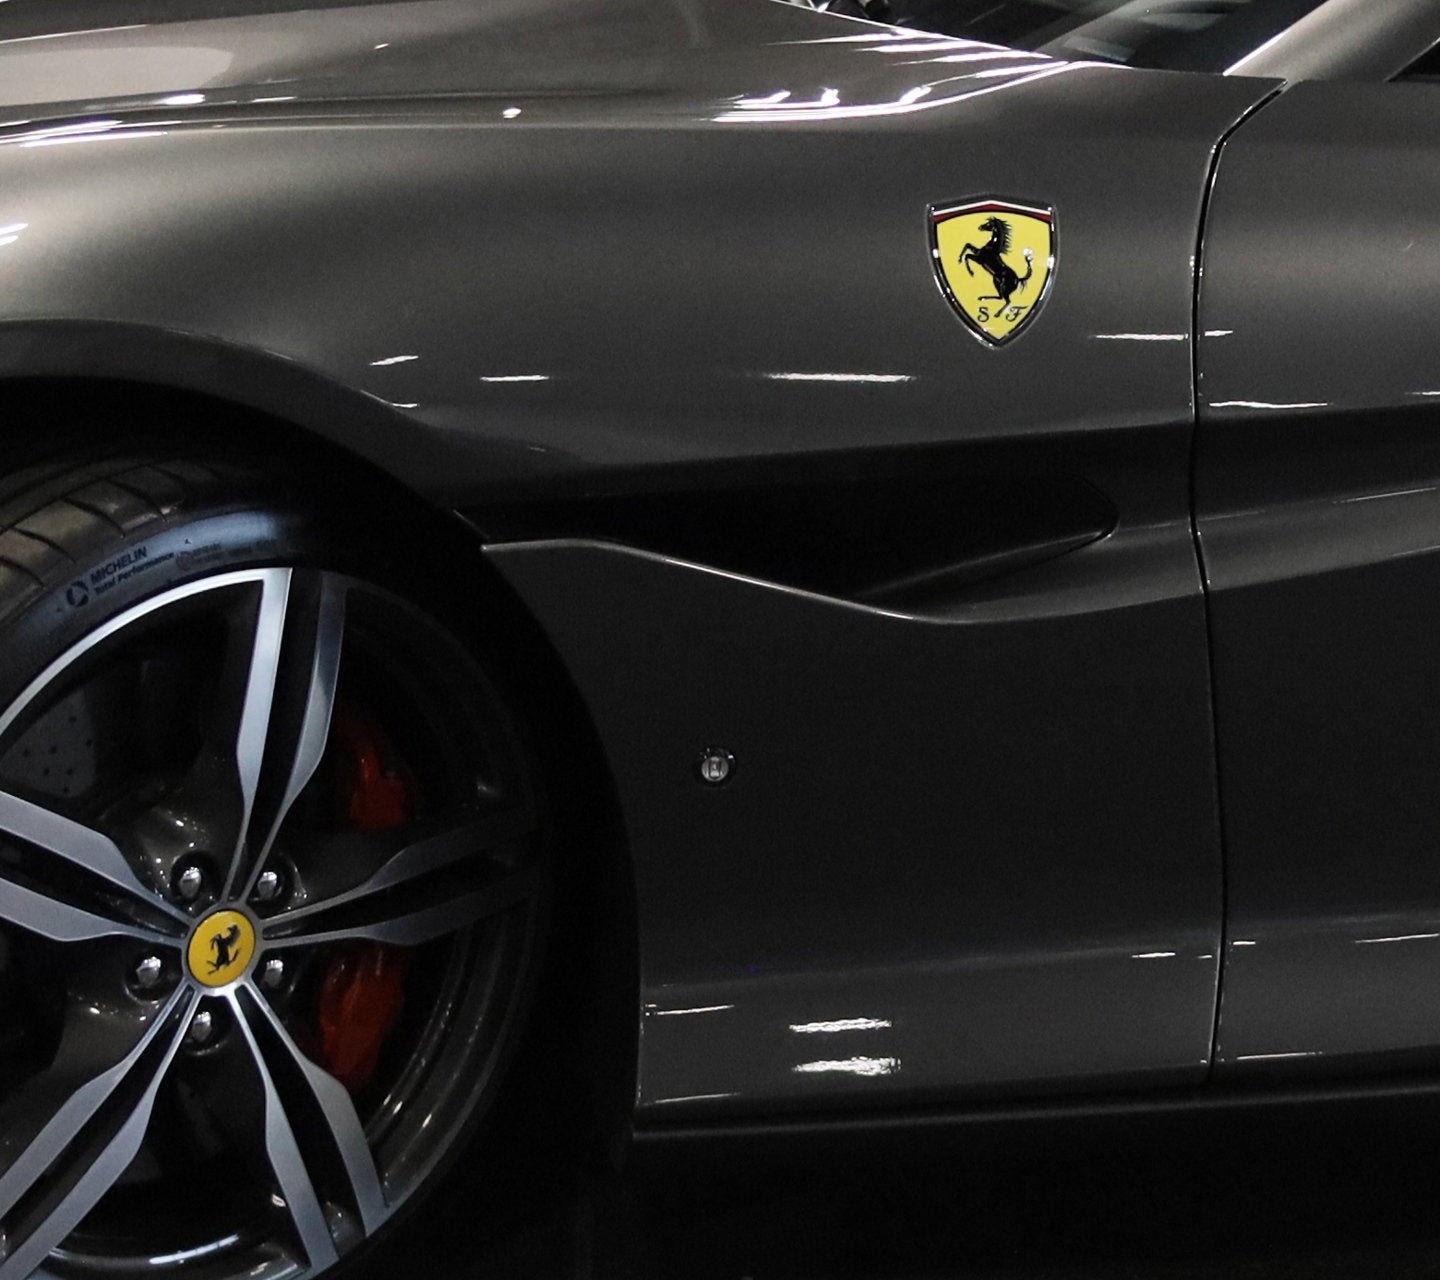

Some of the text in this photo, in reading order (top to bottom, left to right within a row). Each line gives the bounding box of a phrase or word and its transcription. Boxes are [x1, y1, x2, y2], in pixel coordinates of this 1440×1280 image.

[977, 305, 1029, 323] S F
[90, 546, 148, 585] MICHELIN
